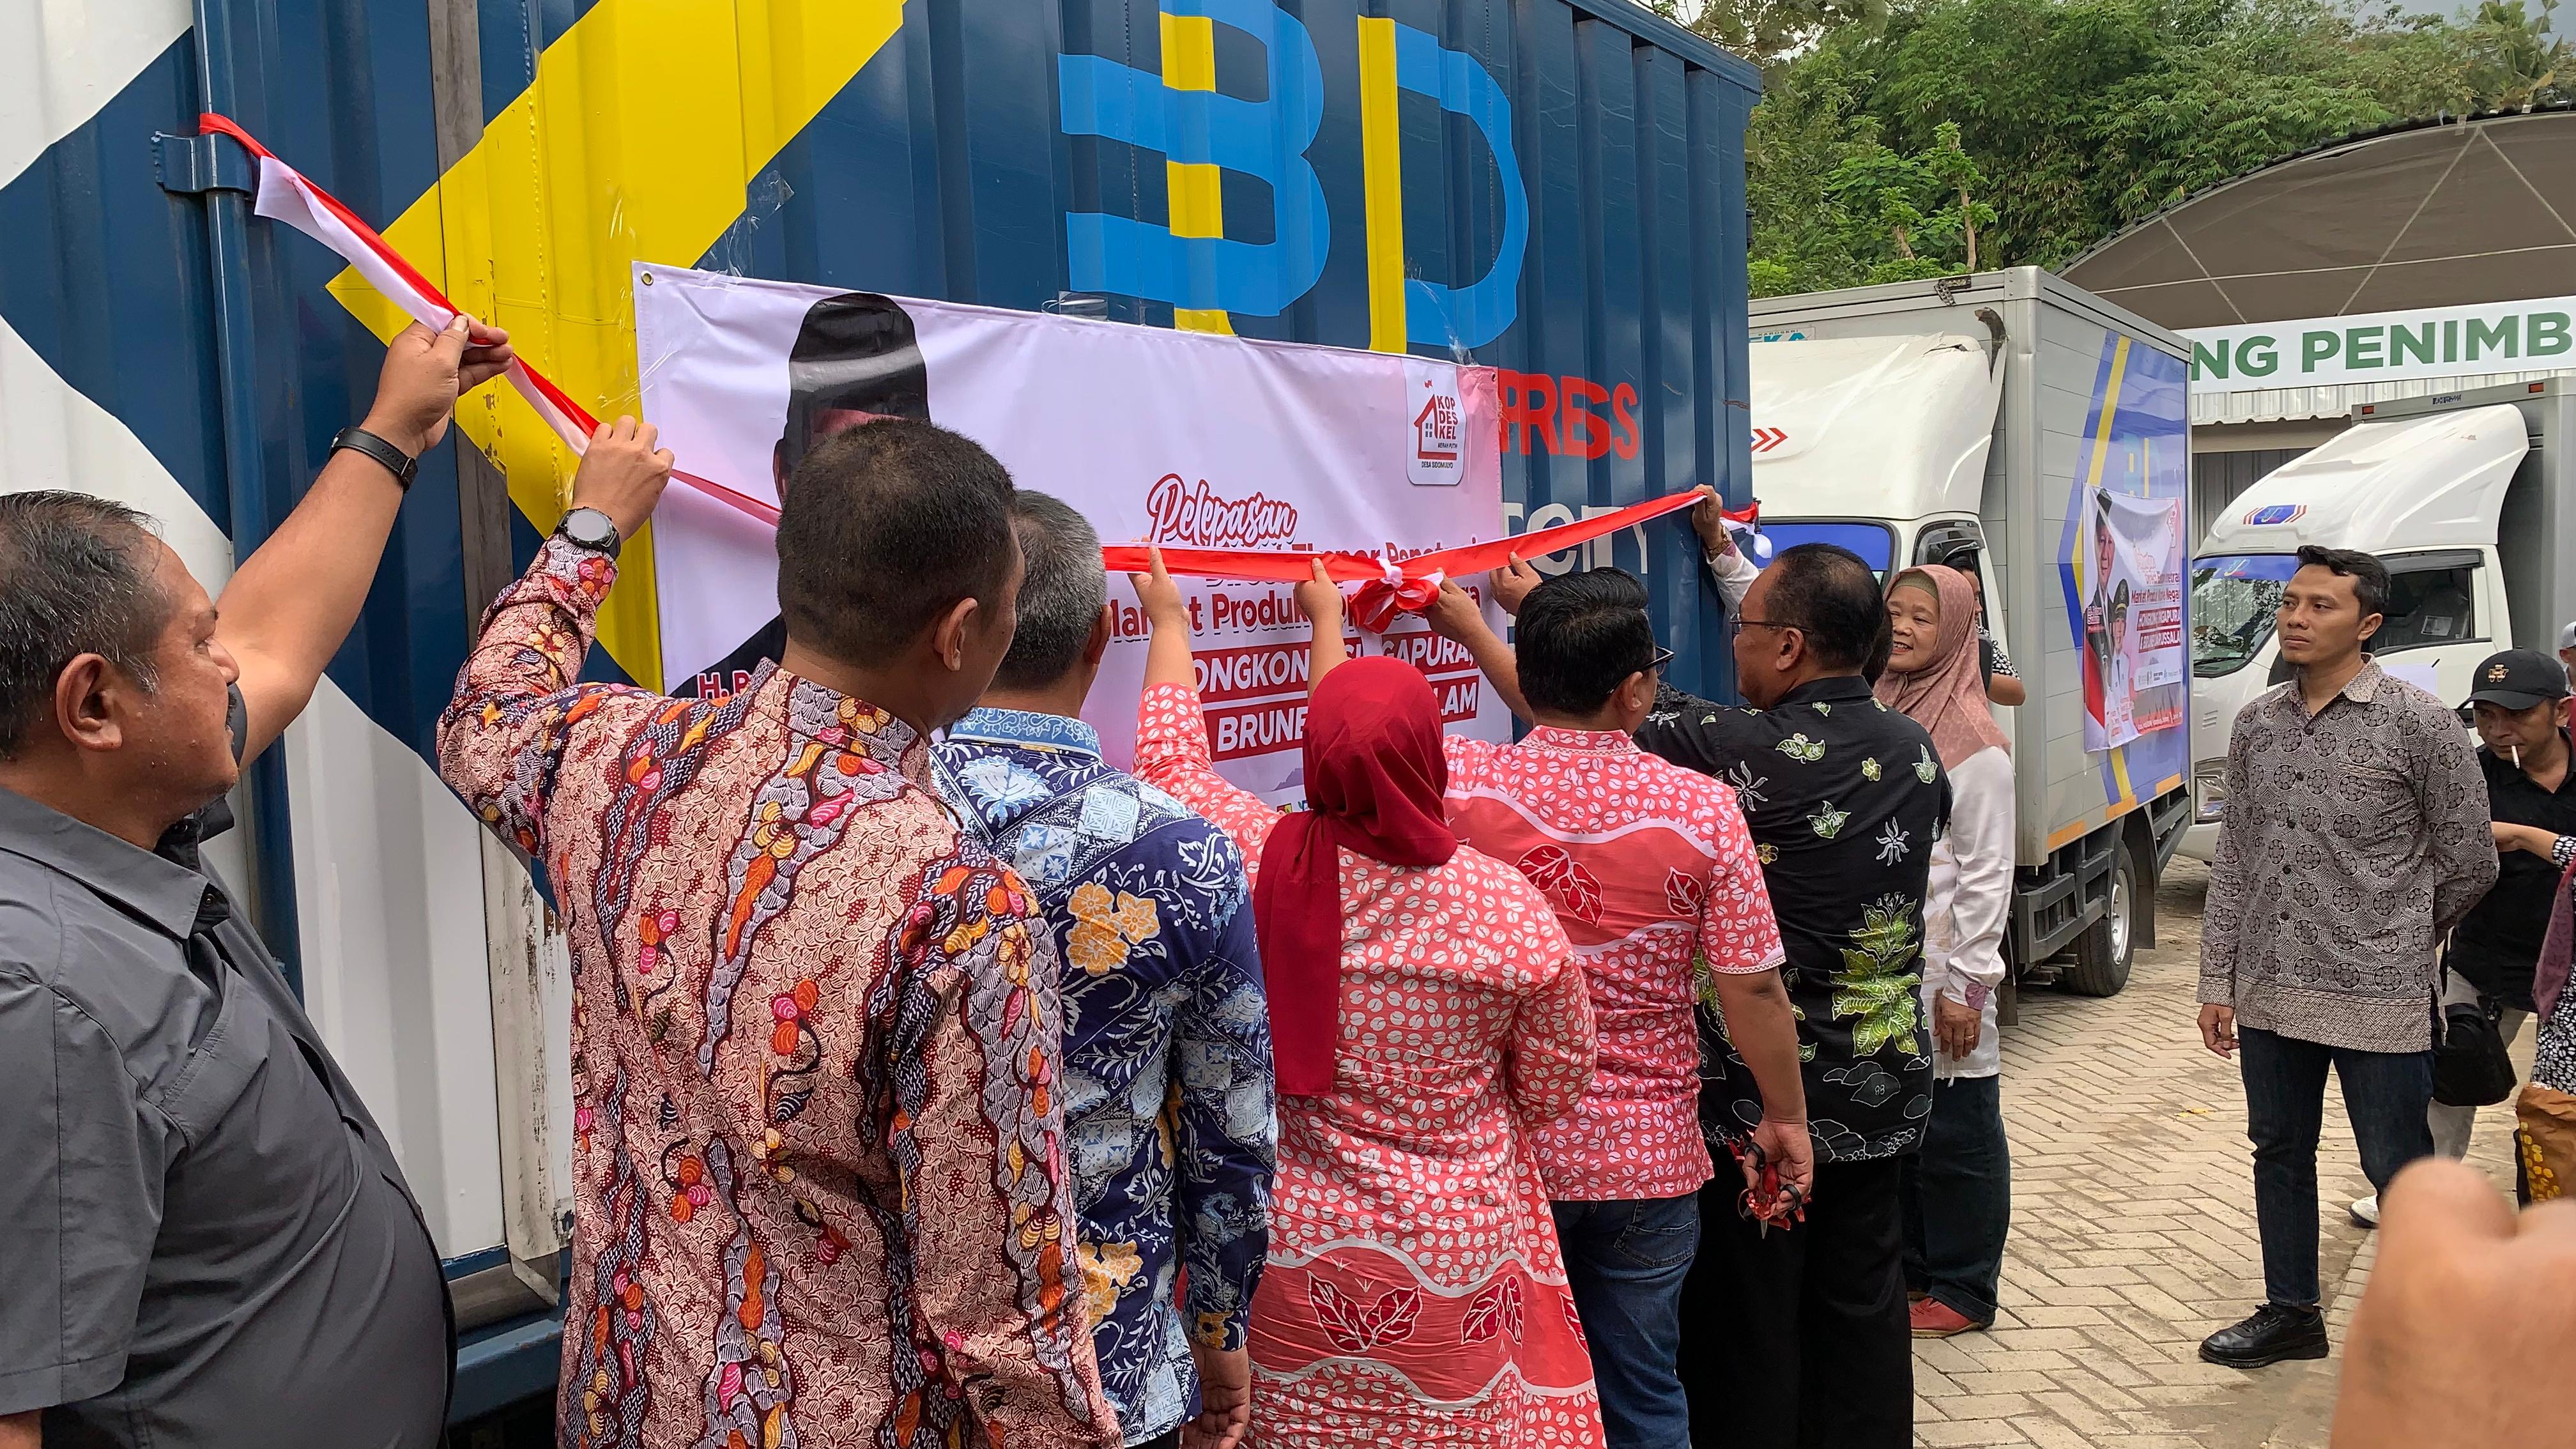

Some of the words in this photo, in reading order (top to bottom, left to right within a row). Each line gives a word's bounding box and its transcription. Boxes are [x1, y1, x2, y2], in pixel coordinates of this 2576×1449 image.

[2302, 312, 2573, 373] PENIMB
[1437, 395, 1455, 410] KOP
[1439, 410, 1459, 425] DES
[1439, 425, 1457, 440] KEL
[1147, 473, 1298, 548] Pelepasan
[1193, 648, 1309, 694] ONGKON
[1216, 706, 1309, 753] BRUNE
